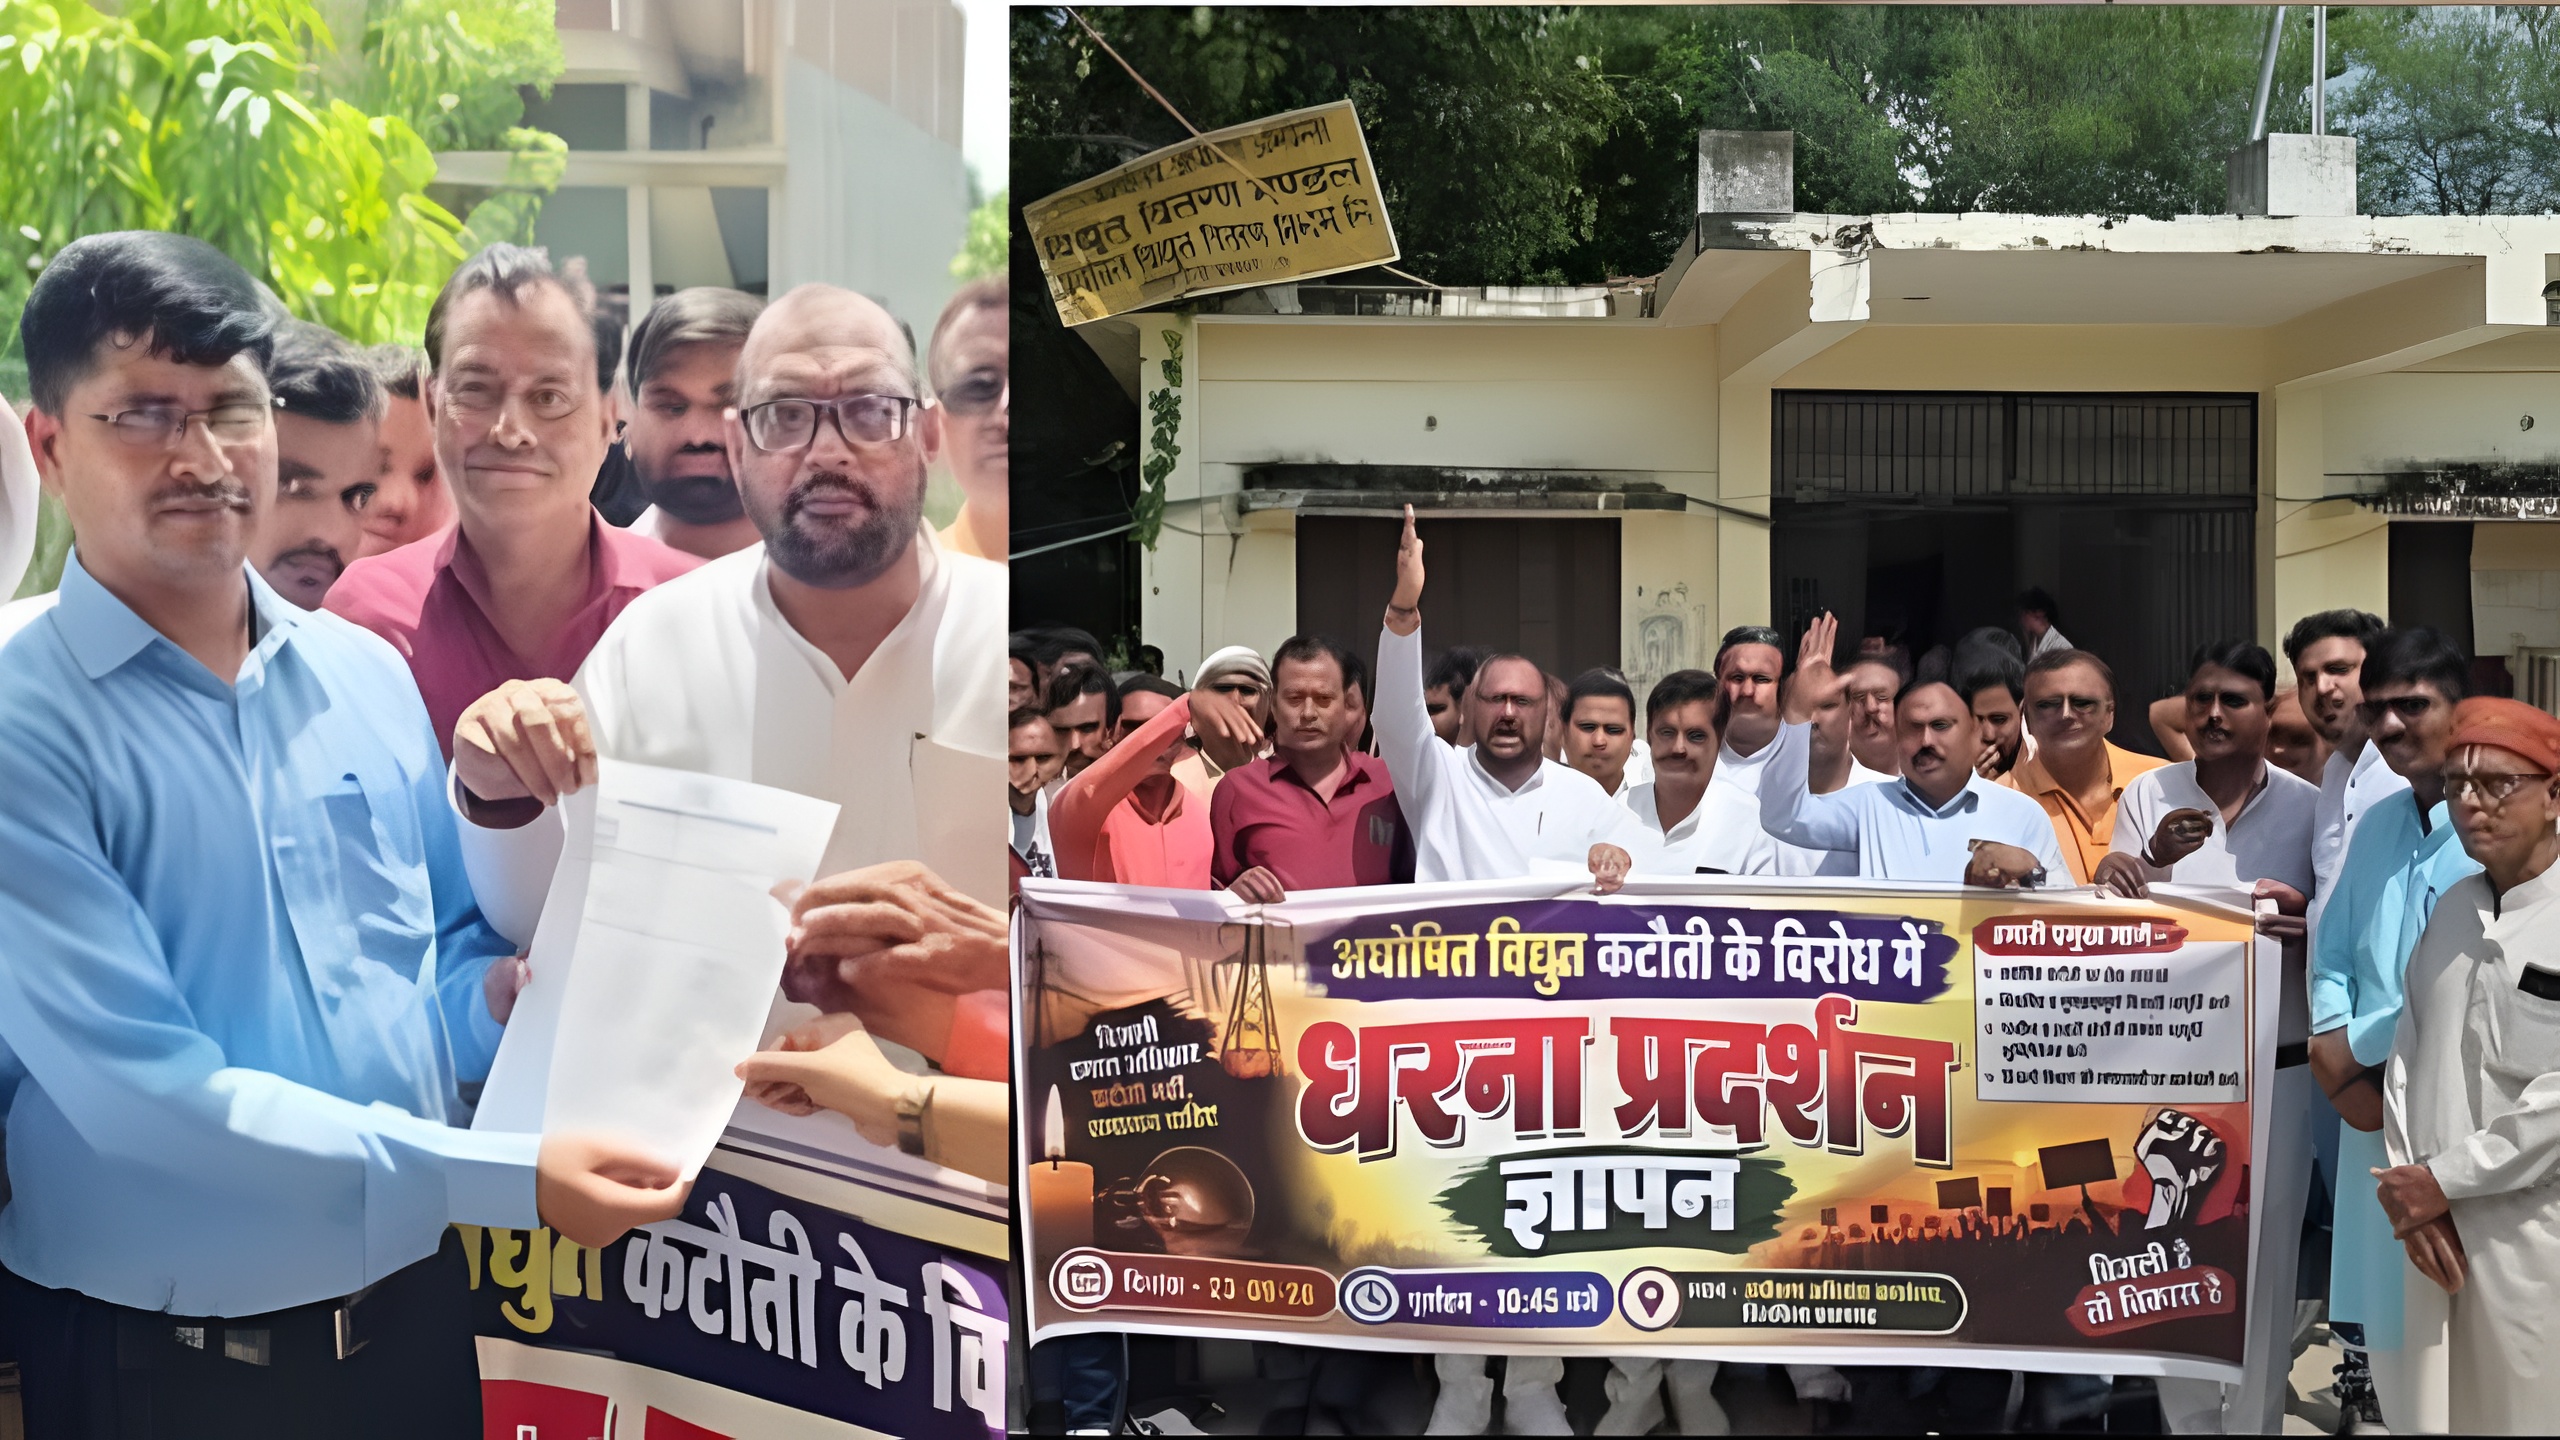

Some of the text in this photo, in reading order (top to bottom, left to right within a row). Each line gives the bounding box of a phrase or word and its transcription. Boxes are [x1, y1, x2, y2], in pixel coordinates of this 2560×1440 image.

[1331, 914, 1929, 996] अघोषित विद्युत कटौती के विरोध में
[1296, 992, 1962, 1171] धरना प्रदर्शन
[1500, 1156, 1742, 1251] ज्ञापन
[451, 1222, 603, 1334] द्युत
[623, 1192, 822, 1369] कटौती
[834, 1232, 909, 1391] के
[1497, 1286, 1559, 1314] 10:45
[2084, 1290, 2114, 1325] तो
